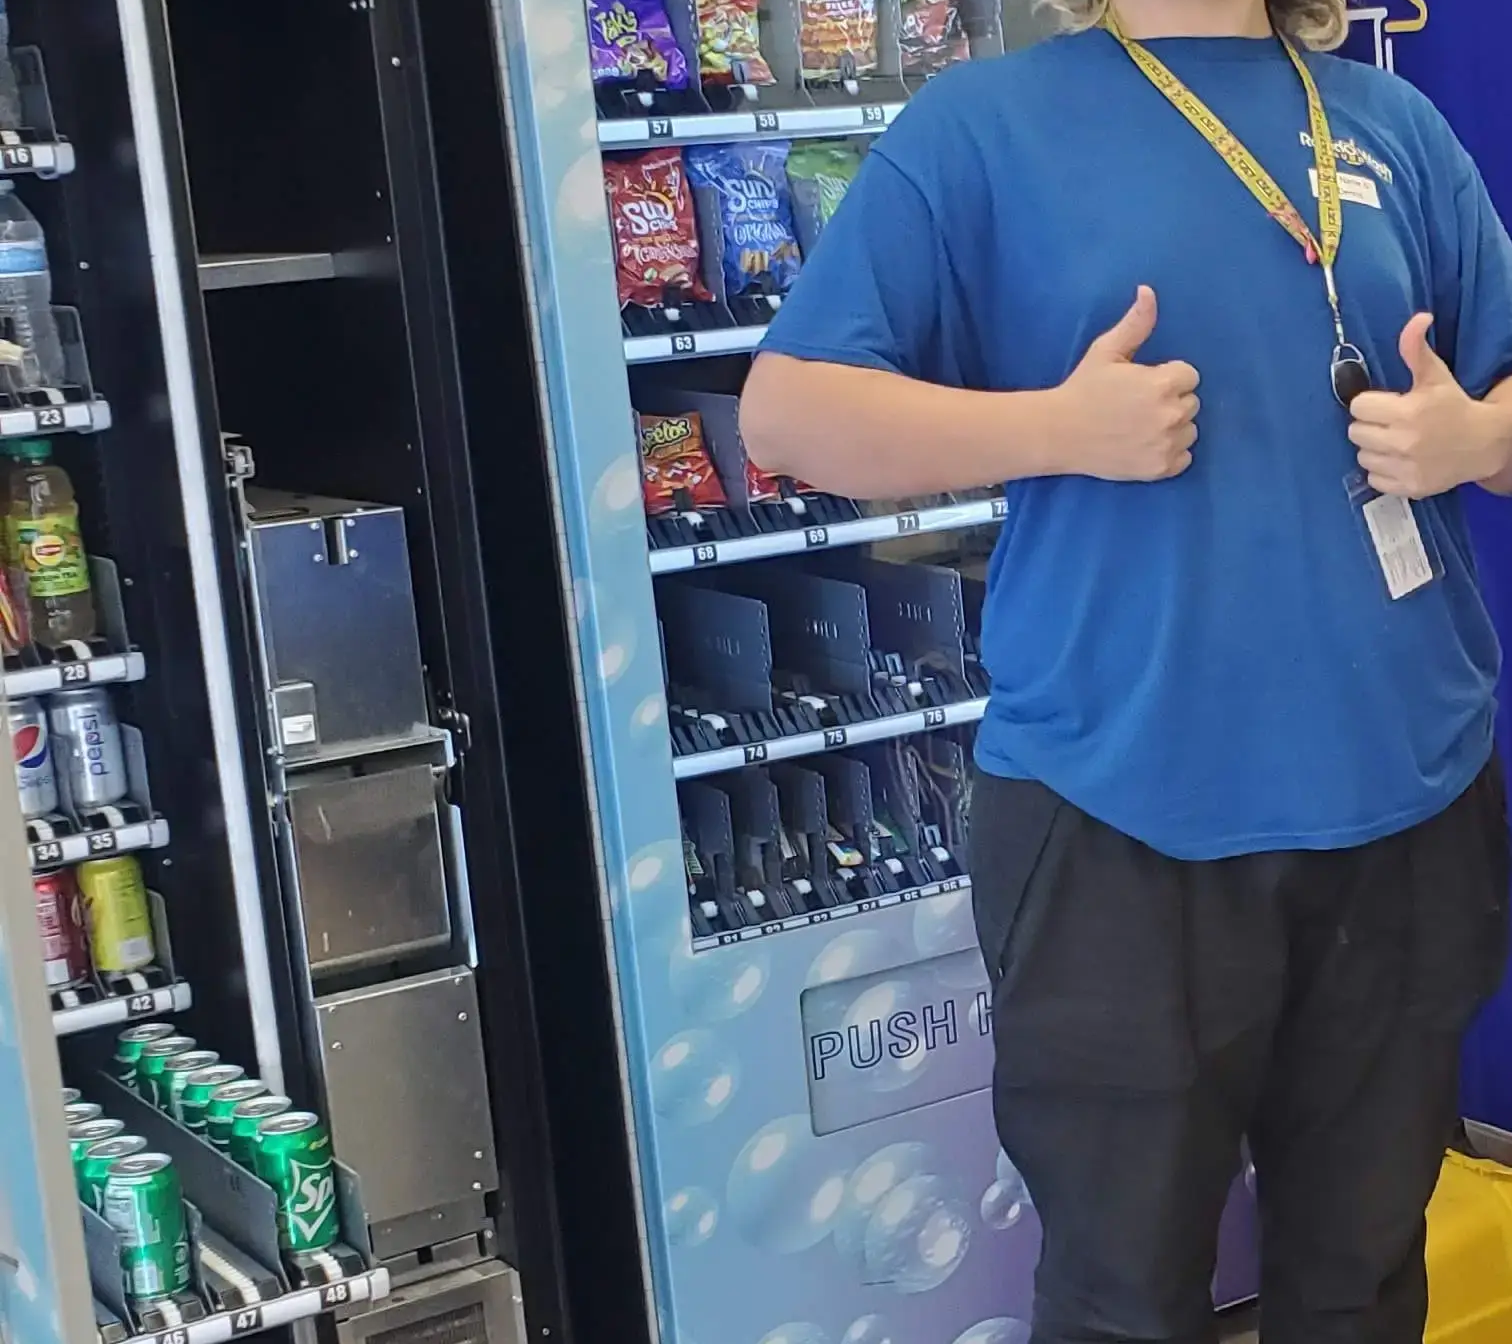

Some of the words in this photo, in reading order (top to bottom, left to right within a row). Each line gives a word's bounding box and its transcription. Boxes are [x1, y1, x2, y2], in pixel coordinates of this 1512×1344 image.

[759, 115, 776, 128] 58
[866, 109, 882, 122] 59
[652, 122, 669, 135] 57
[9, 148, 28, 164] 16
[675, 336, 692, 349] 63
[39, 410, 62, 425] 23
[698, 547, 714, 561] 68
[810, 530, 826, 544] 69
[901, 516, 916, 529] 71
[64, 665, 86, 681] 28
[747, 747, 763, 759] 74
[828, 731, 843, 744] 75
[927, 711, 942, 724] 76
[79, 714, 110, 776] pepsi
[38, 844, 60, 861] 34
[92, 833, 113, 849] 35
[131, 998, 152, 1011] 42
[810, 1000, 958, 1081] PUSH
[235, 1313, 257, 1329] 47
[325, 1286, 347, 1302] 48
